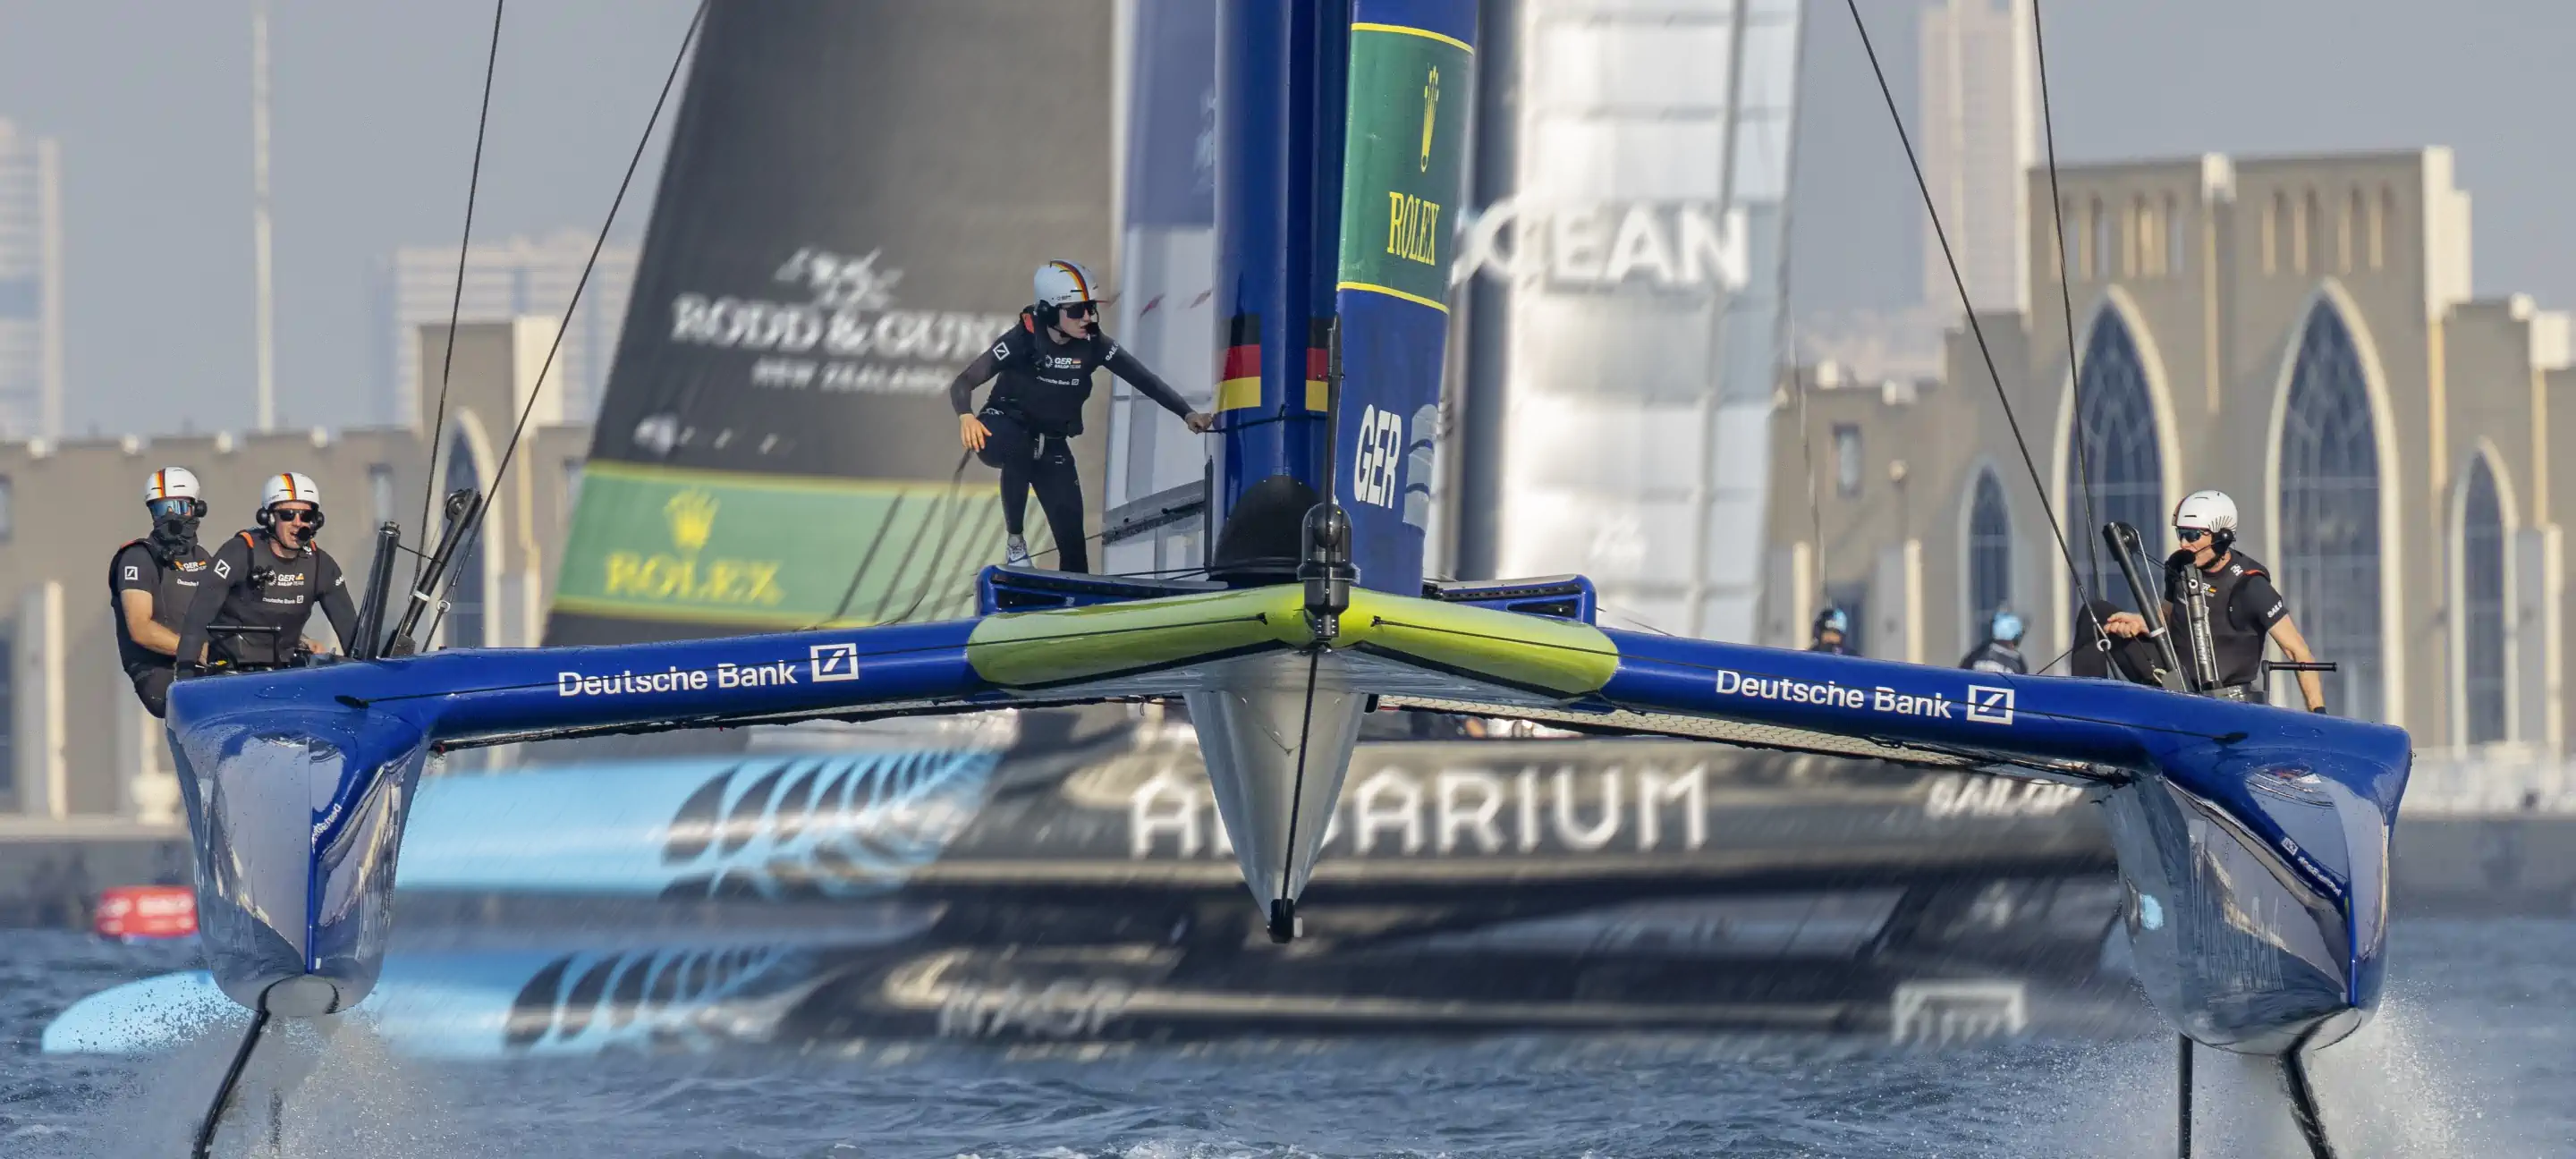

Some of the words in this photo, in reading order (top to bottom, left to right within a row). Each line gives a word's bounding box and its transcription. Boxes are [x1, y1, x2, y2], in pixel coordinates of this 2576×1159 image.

[1387, 191, 1440, 266] ROLEX
[1055, 357, 1072, 365] GER
[1353, 403, 1402, 510] GER
[277, 573, 295, 582] GER
[558, 665, 709, 698] Deutsche
[717, 659, 799, 689] Bank
[1716, 669, 1865, 709] Deutsche
[1874, 685, 1953, 720] Bank
